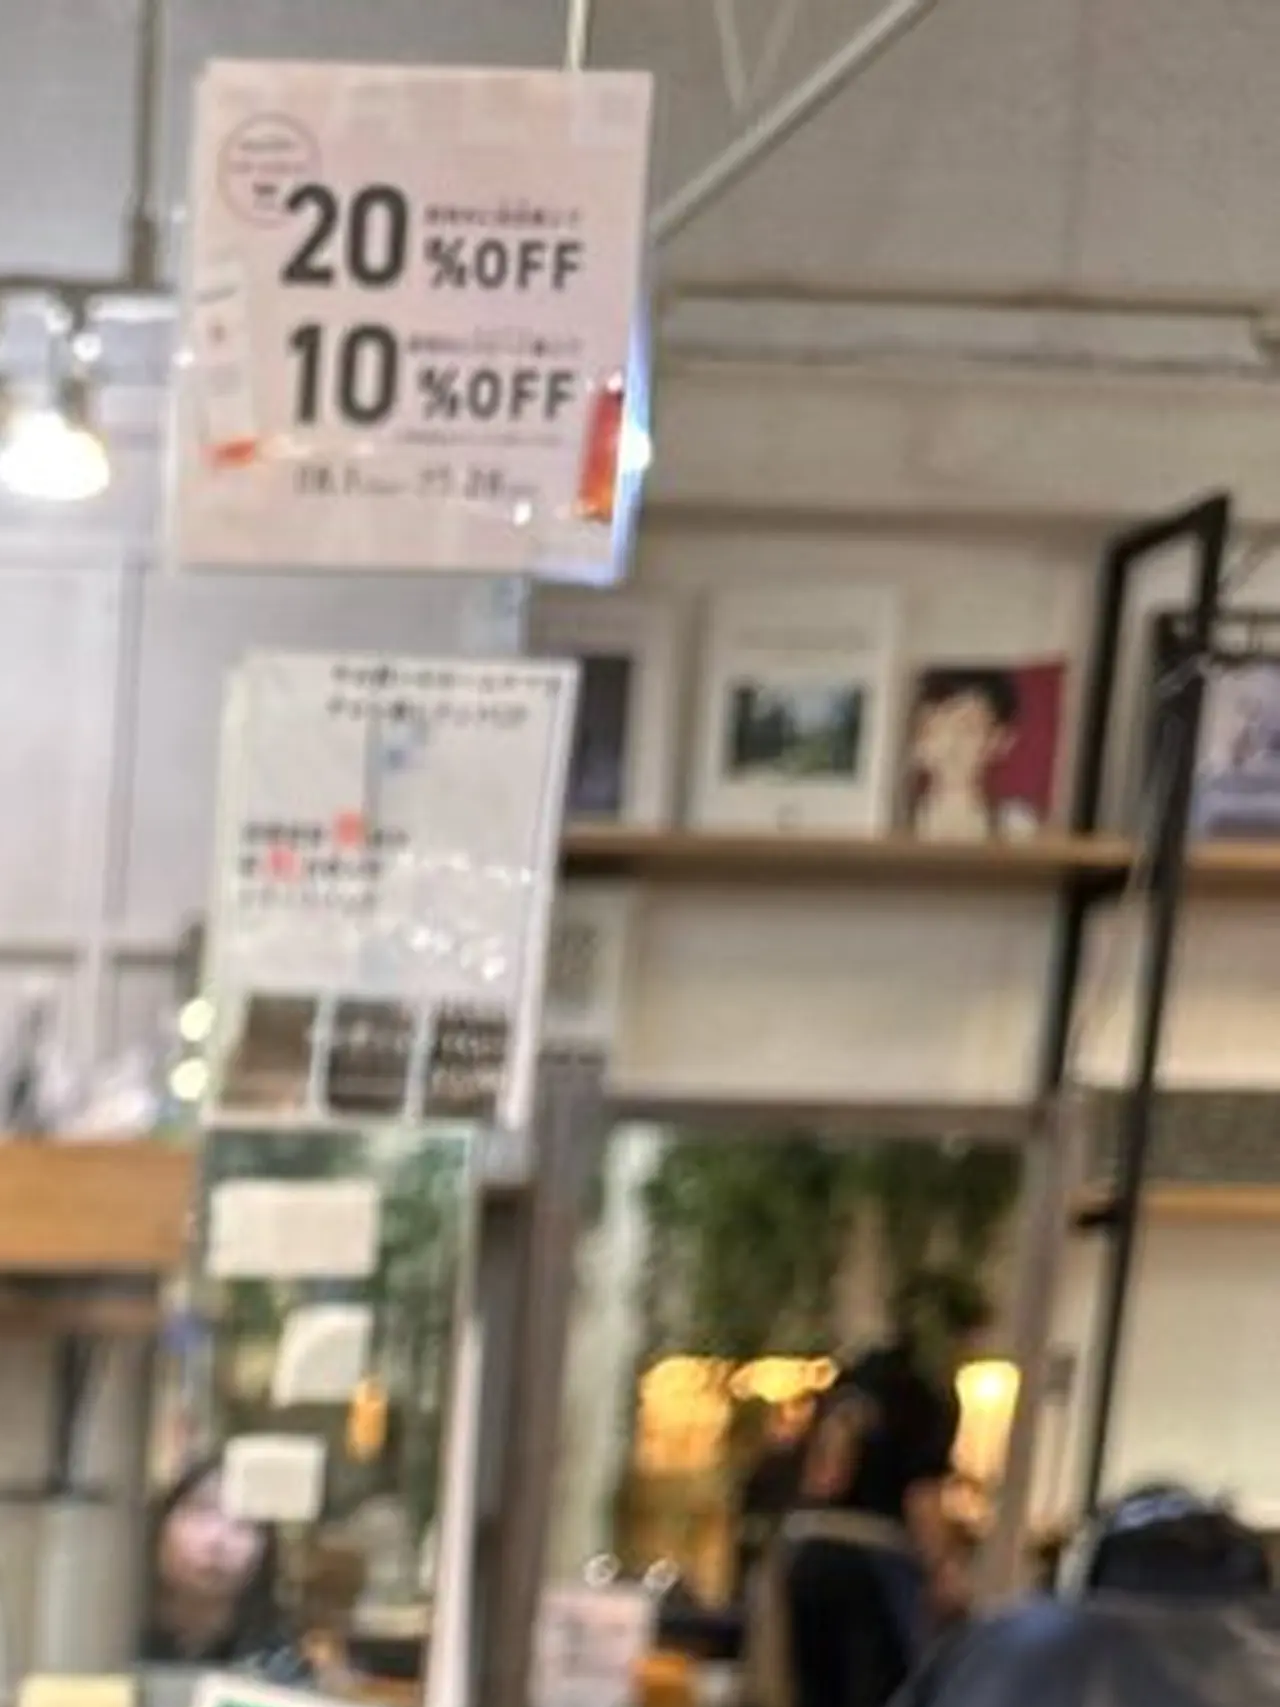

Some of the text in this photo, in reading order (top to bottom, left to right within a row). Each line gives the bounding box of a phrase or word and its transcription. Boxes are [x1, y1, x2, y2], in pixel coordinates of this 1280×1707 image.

[281, 184, 584, 290] 20 %OFF
[289, 323, 575, 426] 10 %OFF
